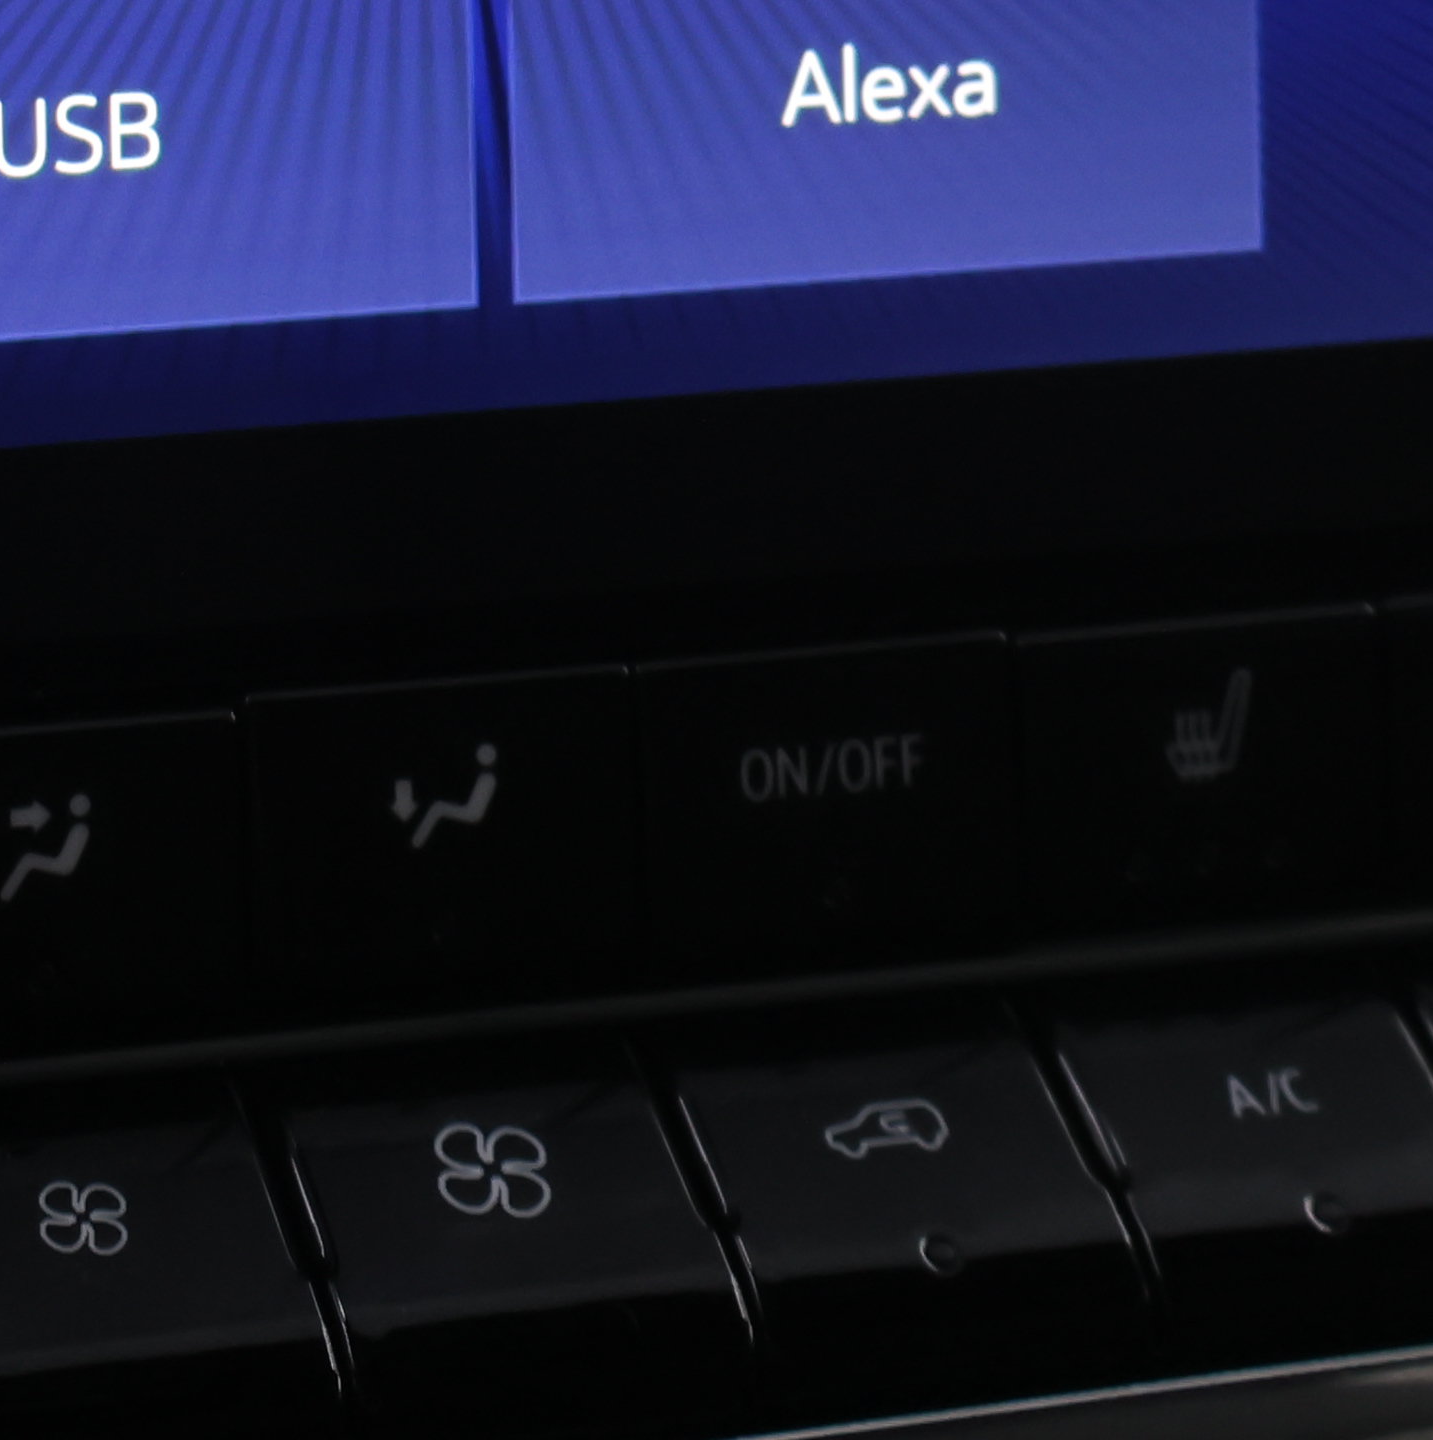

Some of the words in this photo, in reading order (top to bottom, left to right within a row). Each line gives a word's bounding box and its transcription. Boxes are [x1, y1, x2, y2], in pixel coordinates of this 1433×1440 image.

[780, 41, 998, 129] Alexa
[738, 733, 924, 806] ON/OFF
[1226, 1067, 1320, 1120] A/C
